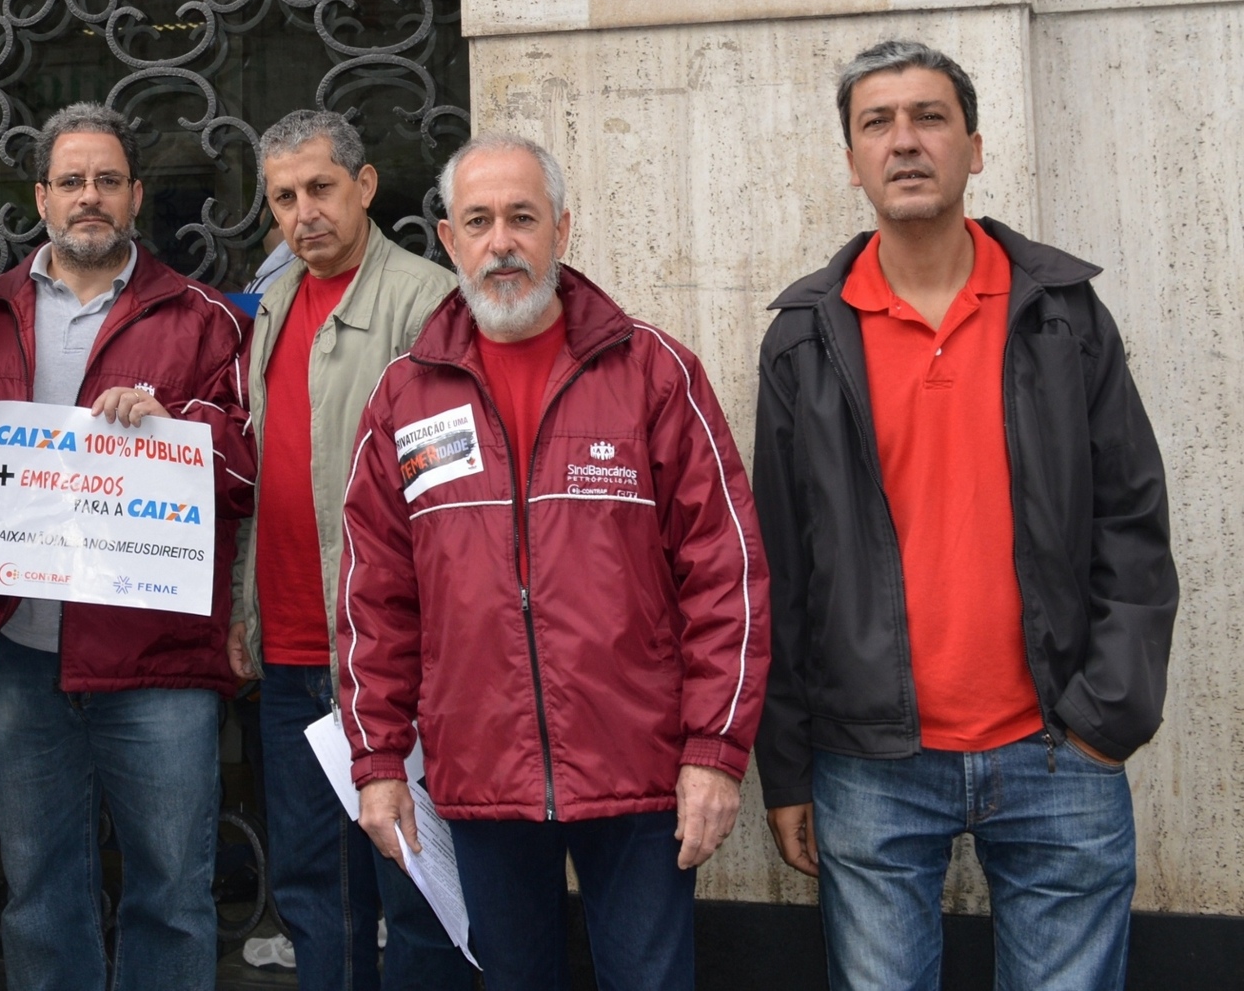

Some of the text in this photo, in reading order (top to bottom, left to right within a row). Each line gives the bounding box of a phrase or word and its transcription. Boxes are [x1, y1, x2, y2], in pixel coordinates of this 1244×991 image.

[453, 416, 468, 428] UMA
[84, 433, 132, 458] 100%
[134, 435, 204, 467] PÚBLICA
[567, 464, 637, 479] SindBancários
[74, 498, 201, 525] PARA A CAIXA
[137, 582, 178, 595] FENAE
